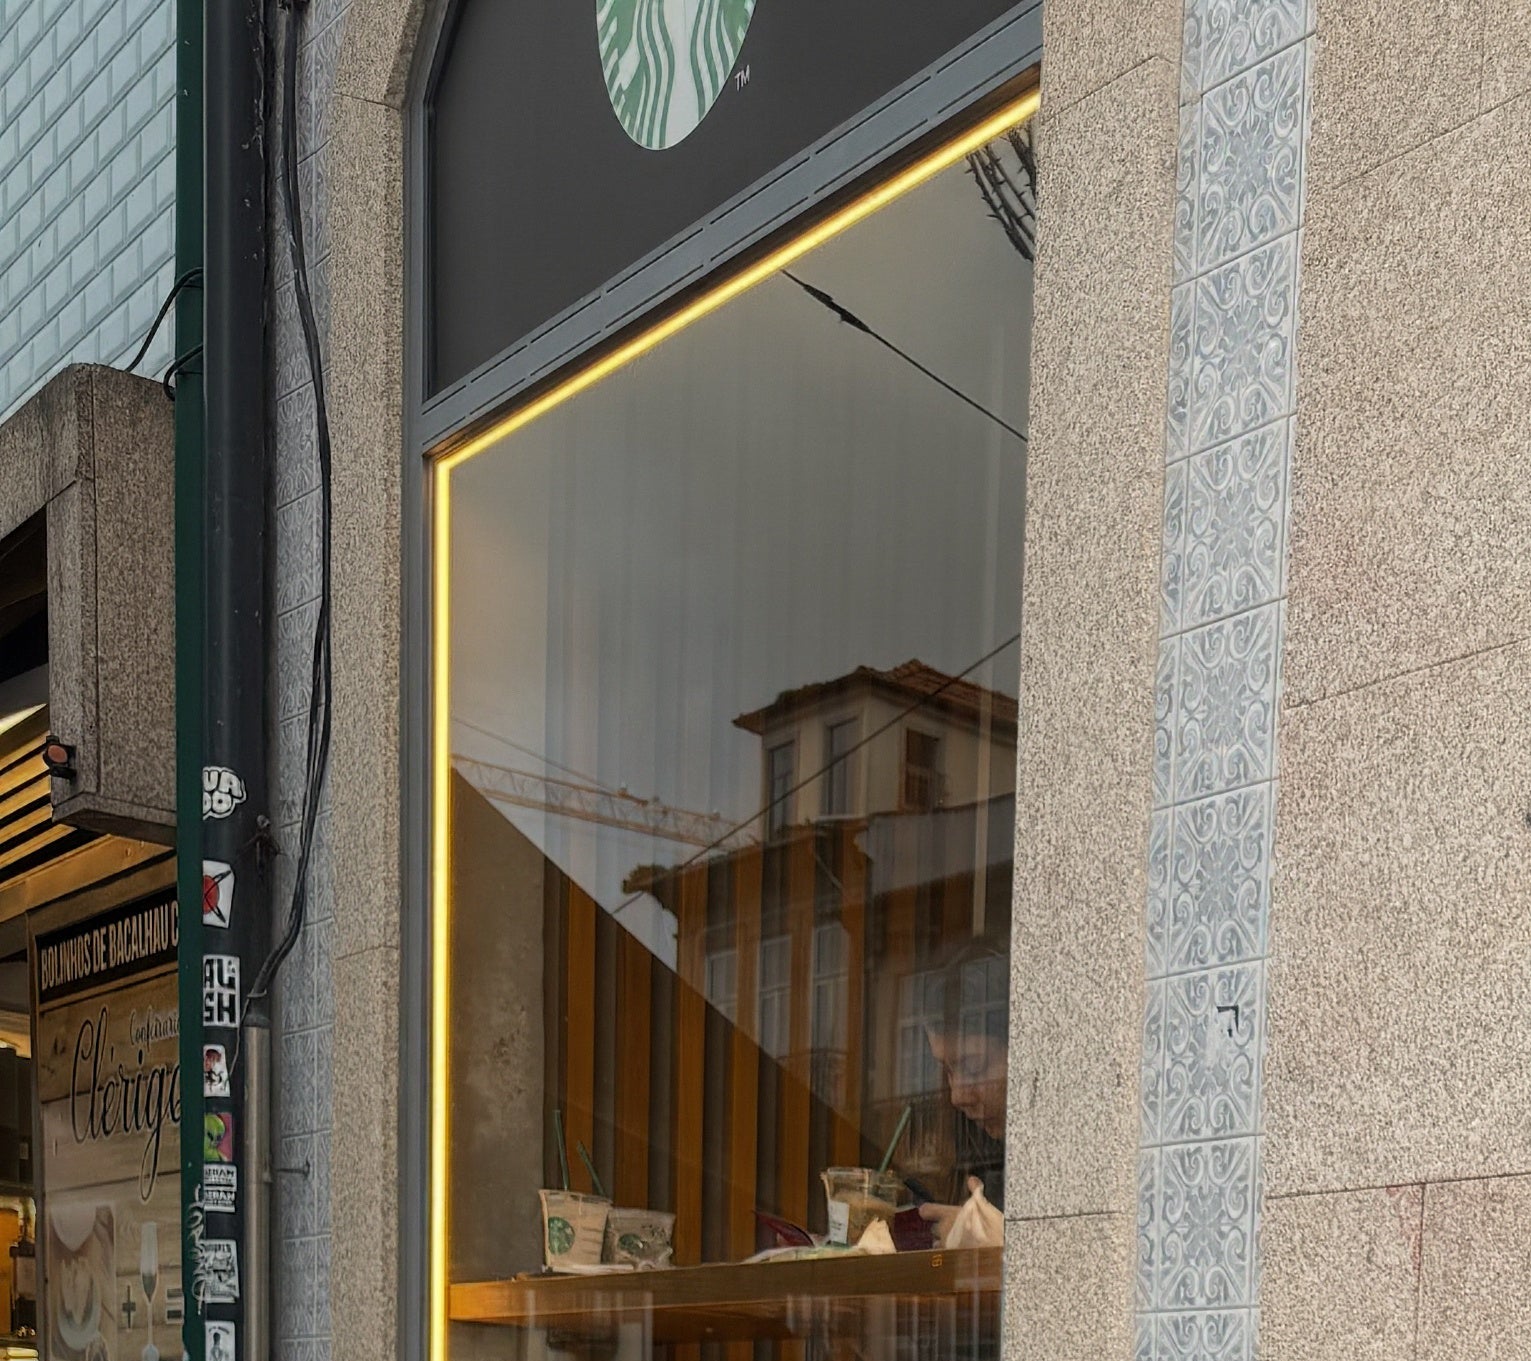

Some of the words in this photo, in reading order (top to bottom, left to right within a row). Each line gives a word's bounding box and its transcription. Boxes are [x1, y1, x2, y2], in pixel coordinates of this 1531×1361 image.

[41, 934, 91, 992] BOLINHOS
[93, 925, 107, 973] DE
[108, 904, 169, 969] BACALHAU
